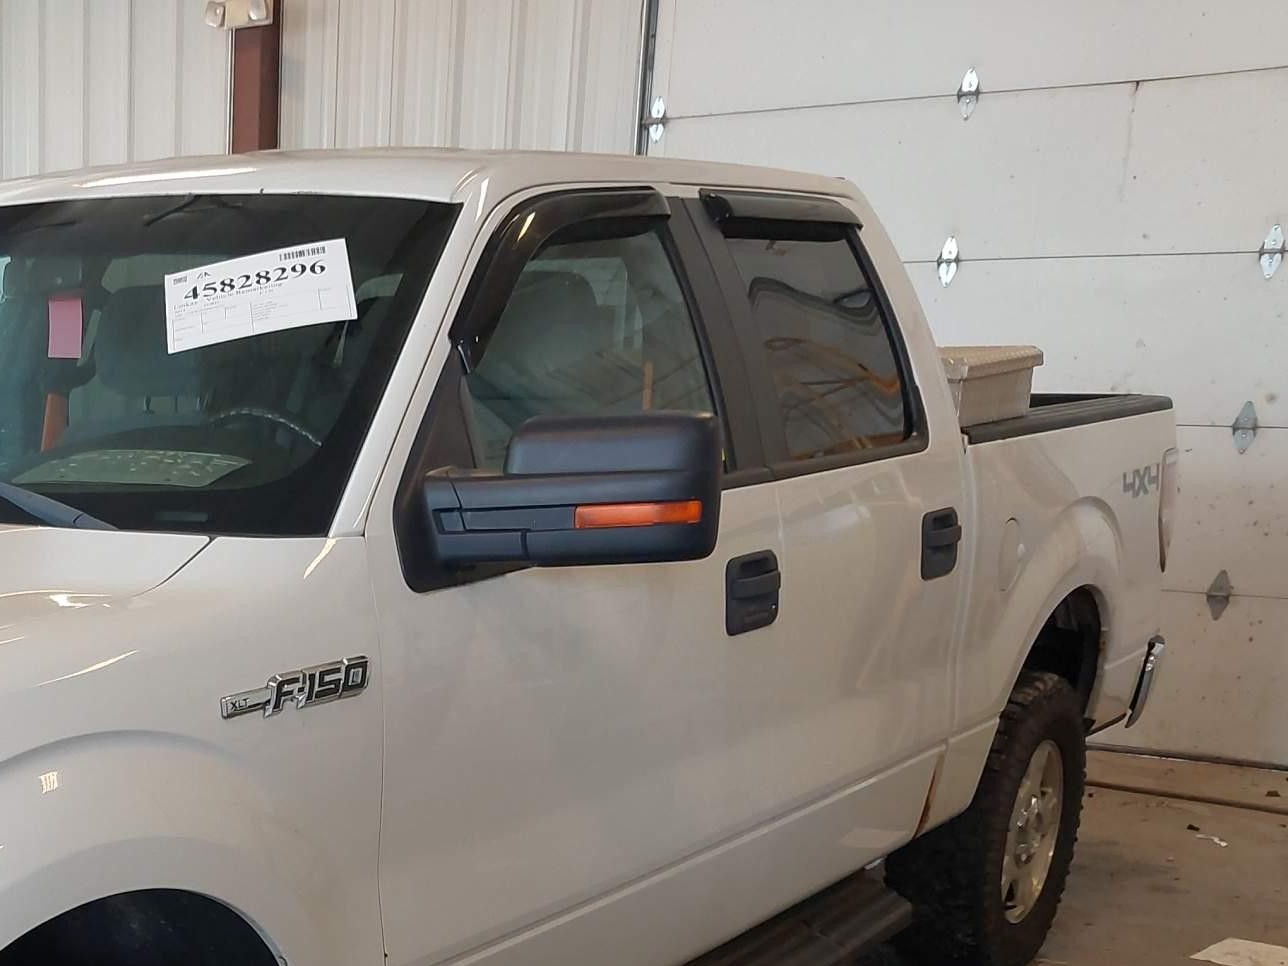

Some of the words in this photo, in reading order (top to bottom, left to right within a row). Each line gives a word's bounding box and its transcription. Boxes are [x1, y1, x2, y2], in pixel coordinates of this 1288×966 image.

[184, 260, 326, 300] 45828296
[230, 697, 250, 711] XLT
[264, 656, 369, 717] F-150
